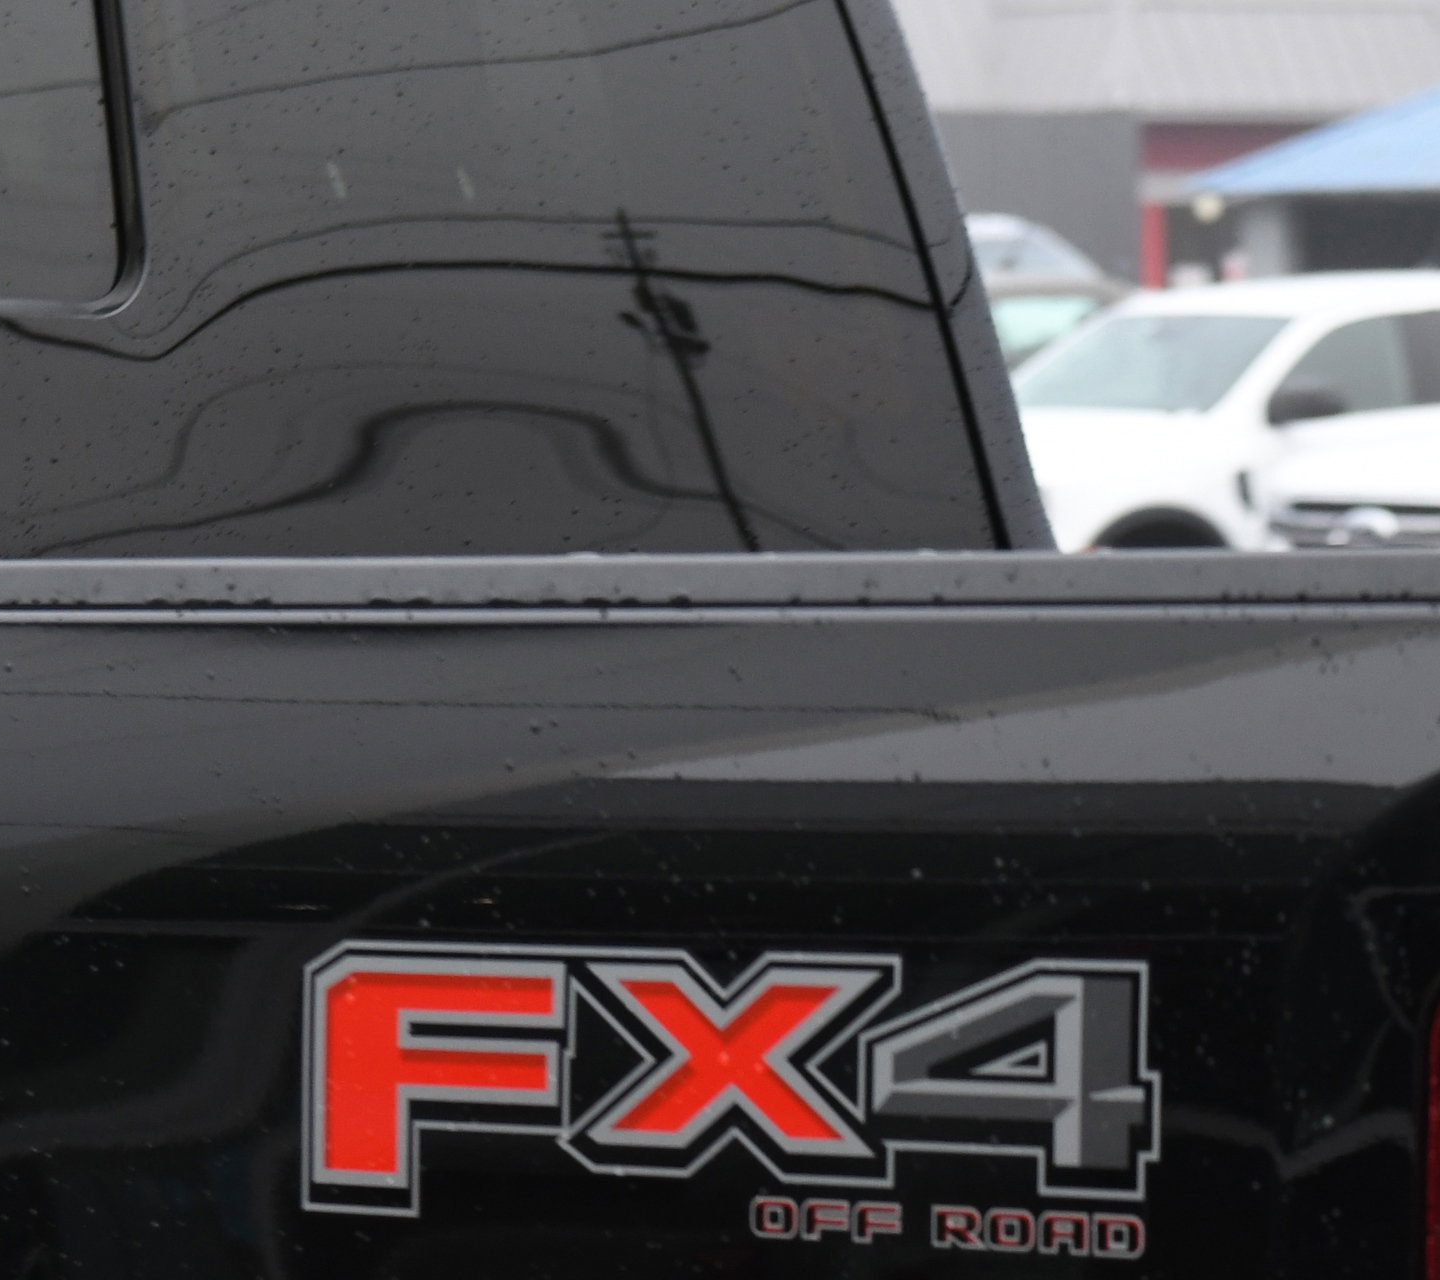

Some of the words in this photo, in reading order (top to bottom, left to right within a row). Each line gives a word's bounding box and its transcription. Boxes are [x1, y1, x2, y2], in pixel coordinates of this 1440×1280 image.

[304, 941, 1159, 1214] FX4
[750, 1195, 903, 1244] OFF
[930, 1202, 1146, 1260] ROAD
